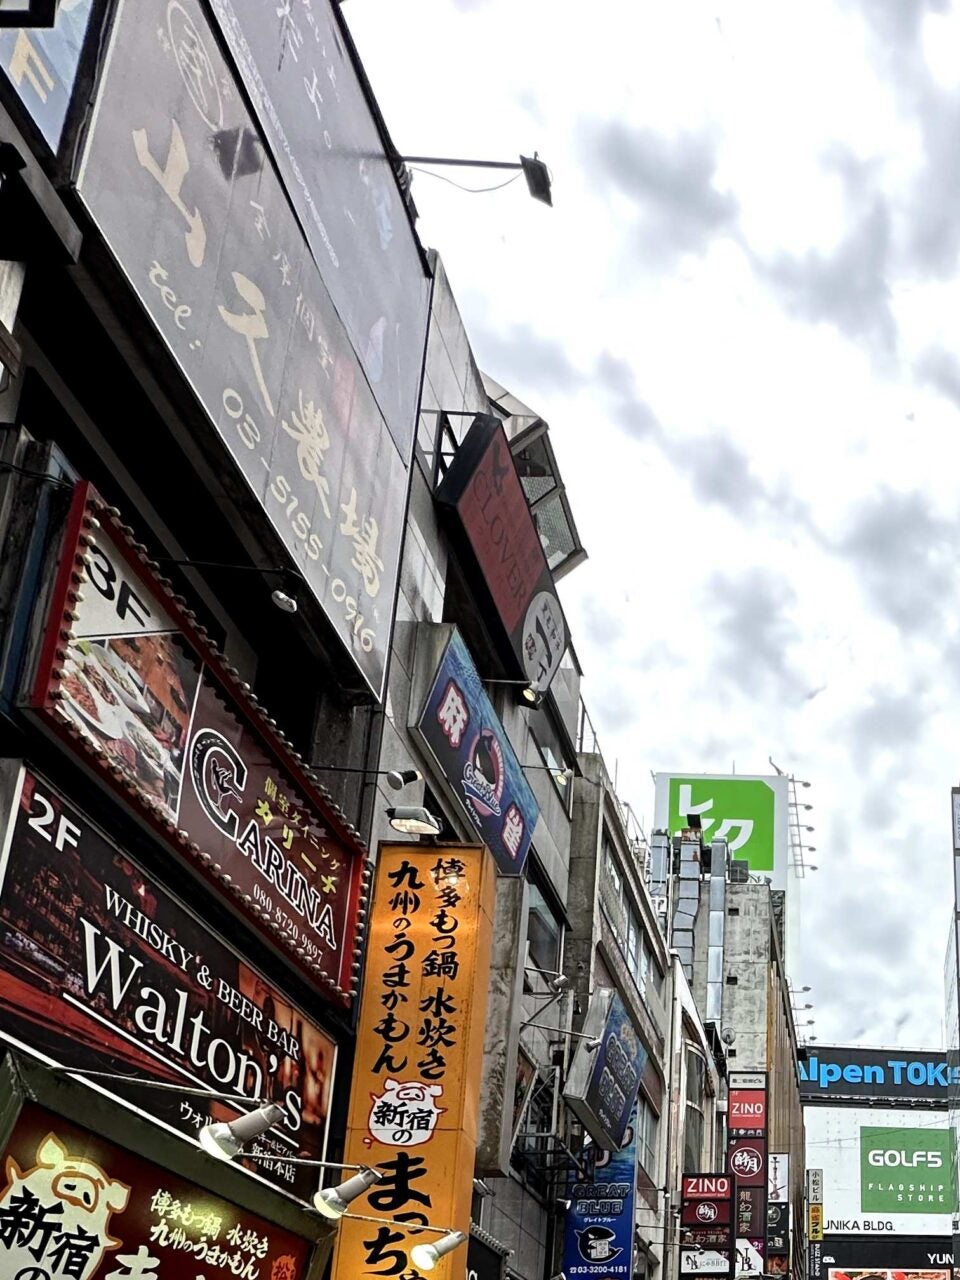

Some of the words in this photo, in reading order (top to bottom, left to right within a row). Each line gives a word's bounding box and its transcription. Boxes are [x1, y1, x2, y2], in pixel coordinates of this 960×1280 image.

[132, 118, 383, 598] 山久農場
[222, 388, 374, 653] 03-5155-0916
[473, 469, 529, 614] CLOVER
[84, 545, 151, 628] 3F
[27, 792, 82, 852] 2F
[190, 728, 338, 950] CARINA
[675, 785, 753, 853] レク
[253, 883, 324, 965] 080-8720-9897
[421, 858, 471, 983] 博多もつ鍋
[104, 883, 194, 972] WHISKY
[196, 964, 212, 991] &
[217, 978, 264, 1032] BEER
[266, 1019, 300, 1061] BAR
[370, 860, 424, 1076] 九州のうまかもん
[79, 916, 302, 1132] Walton's
[417, 986, 458, 1080] 水炊き
[371, 1099, 436, 1144] 新宿の
[731, 1103, 764, 1115] ZINO
[686, 1178, 728, 1193] ZINO
[867, 1149, 943, 1168] GOLF5
[868, 1183, 945, 1192] FLAGSHIP
[150, 1188, 223, 1240] 博多もつ鍋
[226, 1223, 269, 1259] 水炊き
[863, 1220, 896, 1232] BLDG.
[897, 1194, 945, 1203] STORE
[150, 1219, 261, 1280] 九州のうまかもん
[577, 1266, 628, 1274] 03-3200-4181
